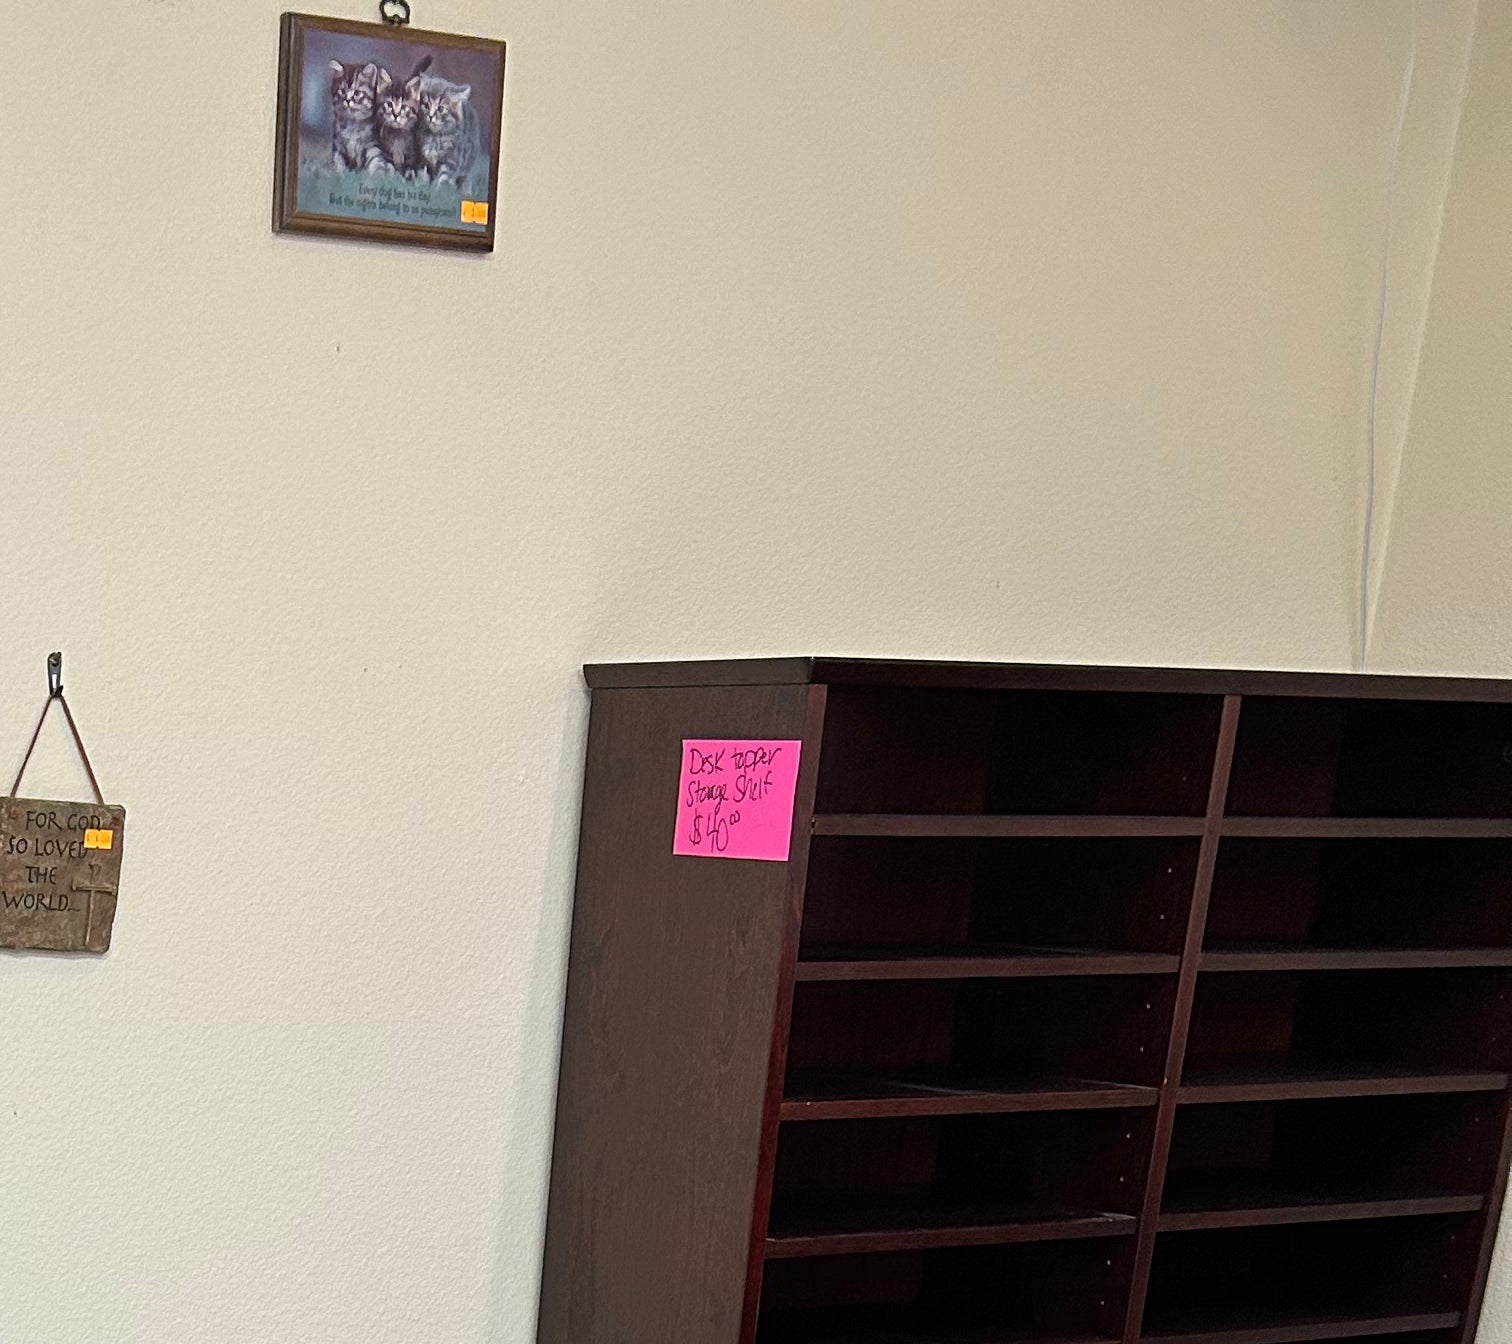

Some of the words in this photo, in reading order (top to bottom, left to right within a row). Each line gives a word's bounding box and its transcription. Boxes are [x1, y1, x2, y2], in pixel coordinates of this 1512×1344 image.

[26, 811, 63, 831] FOR
[67, 814, 101, 832] GOD
[7, 835, 28, 854] SO
[34, 838, 89, 859] LOVED
[25, 866, 57, 884] THE
